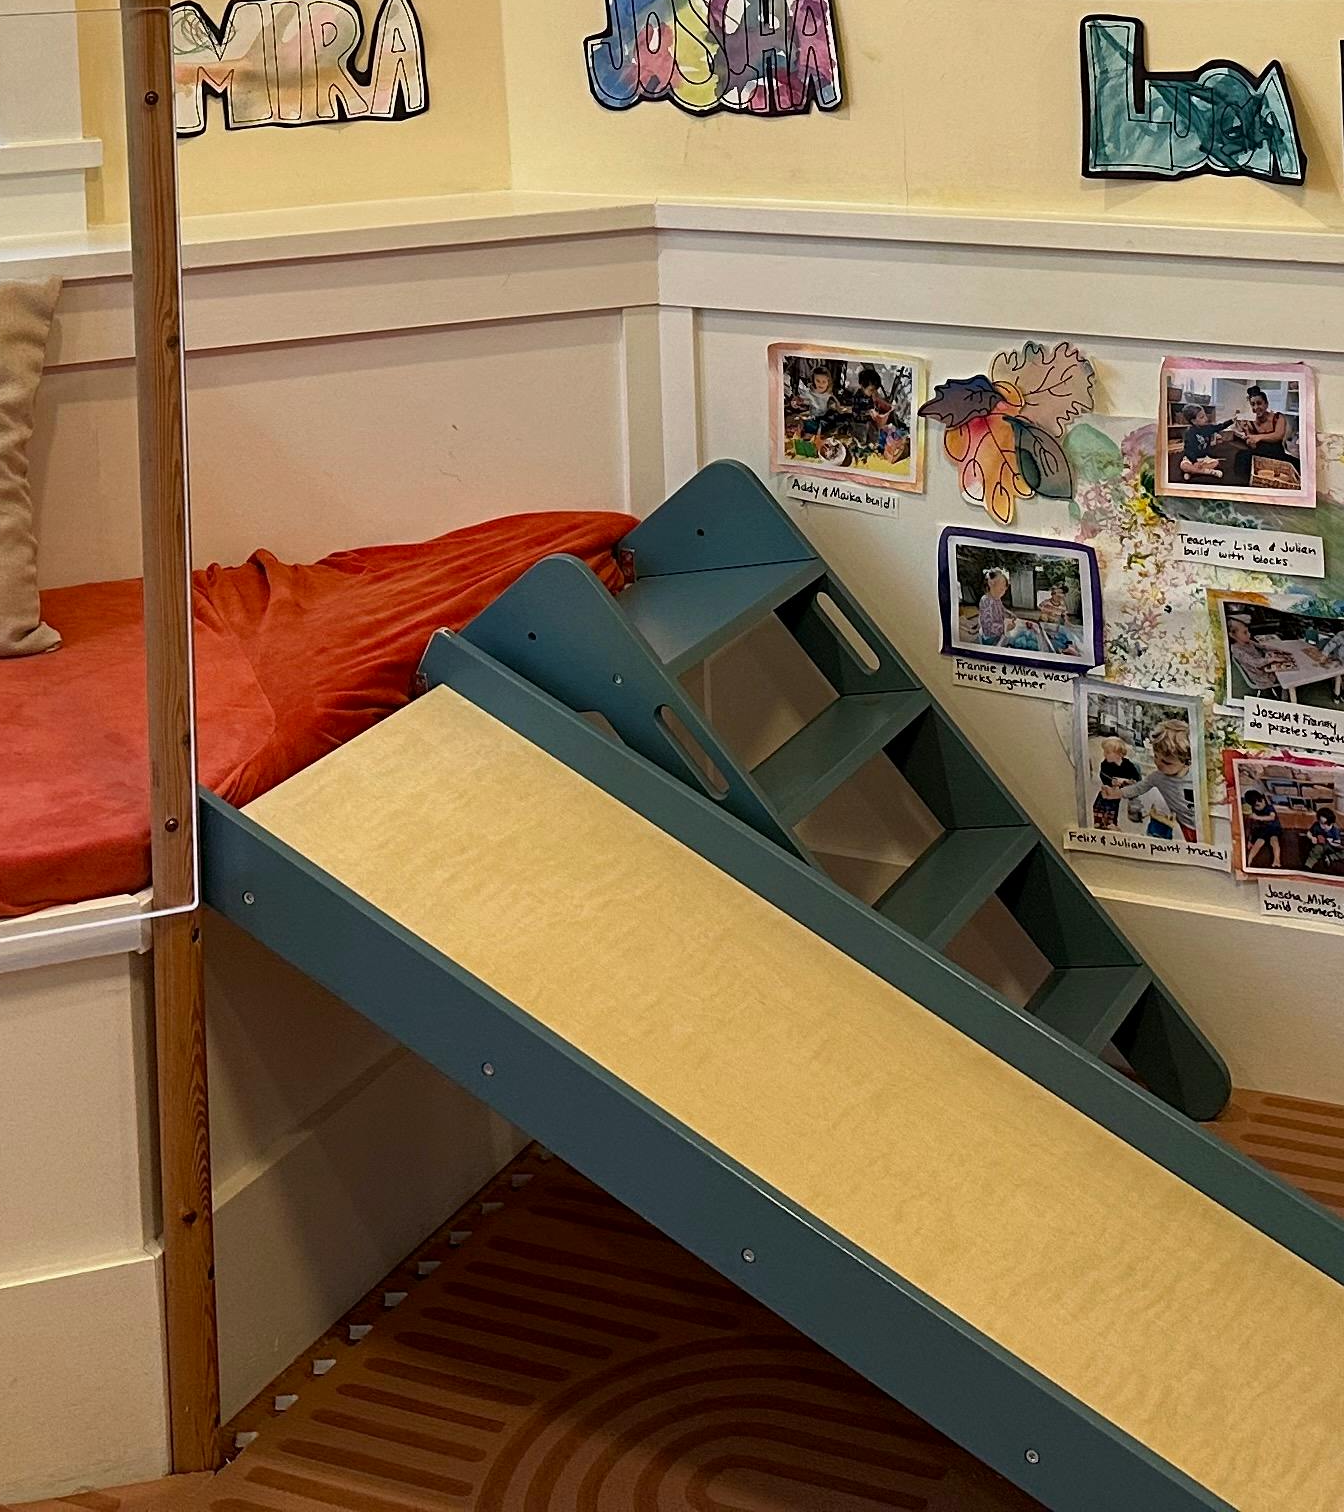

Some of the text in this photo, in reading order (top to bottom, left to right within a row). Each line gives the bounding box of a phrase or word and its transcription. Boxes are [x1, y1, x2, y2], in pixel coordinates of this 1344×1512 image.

[792, 478, 820, 499] Addy
[830, 488, 862, 503] Maika
[1178, 533, 1225, 546] Teacher
[1234, 541, 1260, 552] Lisa
[1280, 541, 1316, 555] Julian
[1184, 546, 1210, 556] build
[1219, 551, 1245, 561] with
[955, 659, 997, 674] Frannie
[1010, 665, 1039, 678] Mira
[955, 671, 992, 684] trucks
[1250, 718, 1262, 729] do
[1268, 723, 1307, 737] puzzles
[1068, 831, 1097, 843] Felix
[1110, 837, 1146, 850] Julian
[1150, 843, 1181, 855] paint
[1264, 900, 1291, 912] build
